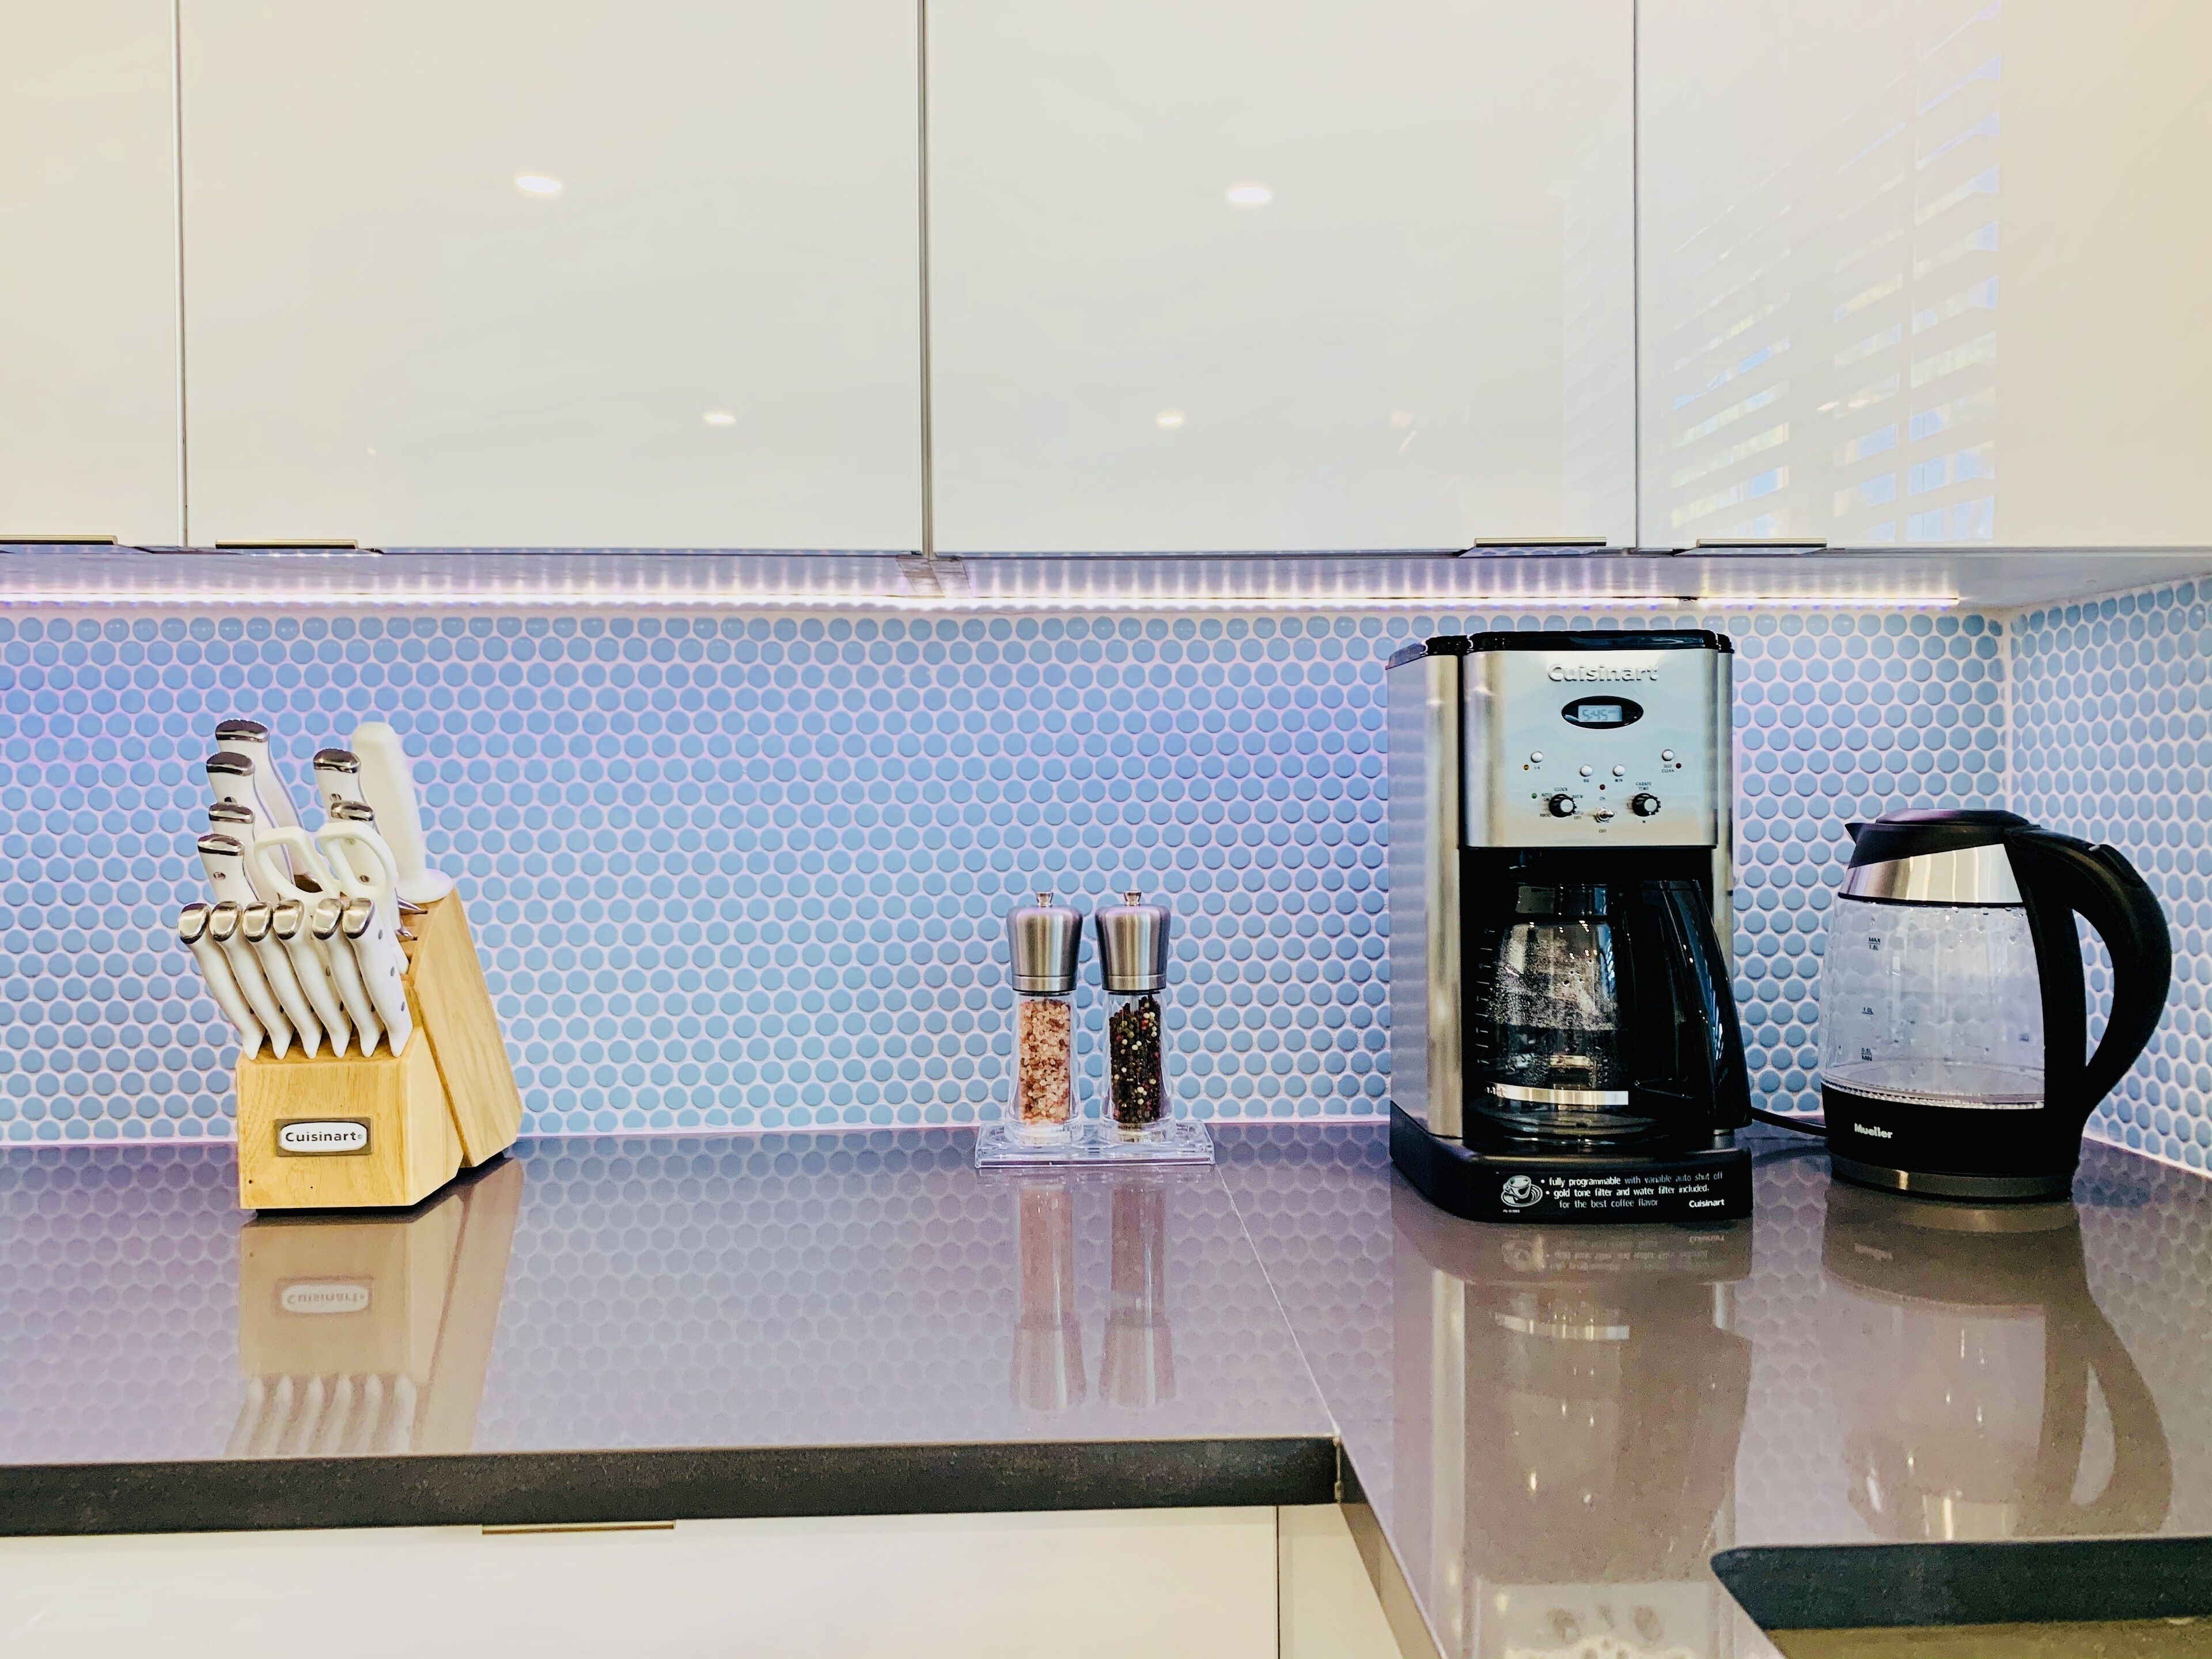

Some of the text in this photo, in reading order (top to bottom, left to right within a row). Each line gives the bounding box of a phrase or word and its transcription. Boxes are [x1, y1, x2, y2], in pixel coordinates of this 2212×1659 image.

[1548, 664, 1658, 681] Cuisinart
[1582, 709, 1608, 721] 5:45
[1854, 1123, 1893, 1139] Mueller
[1549, 1171, 1723, 1188] fully programmable with variable auto shut off
[1554, 1188, 1570, 1199] gold
[1574, 1189, 1591, 1197] tone
[1594, 1188, 1612, 1196] filter
[1616, 1187, 1630, 1196] and
[1633, 1187, 1654, 1196] water
[1658, 1185, 1675, 1194] filter
[1559, 1198, 1658, 1209] for the best coffee flavor
[1689, 1199, 1725, 1208] Cuisinart
